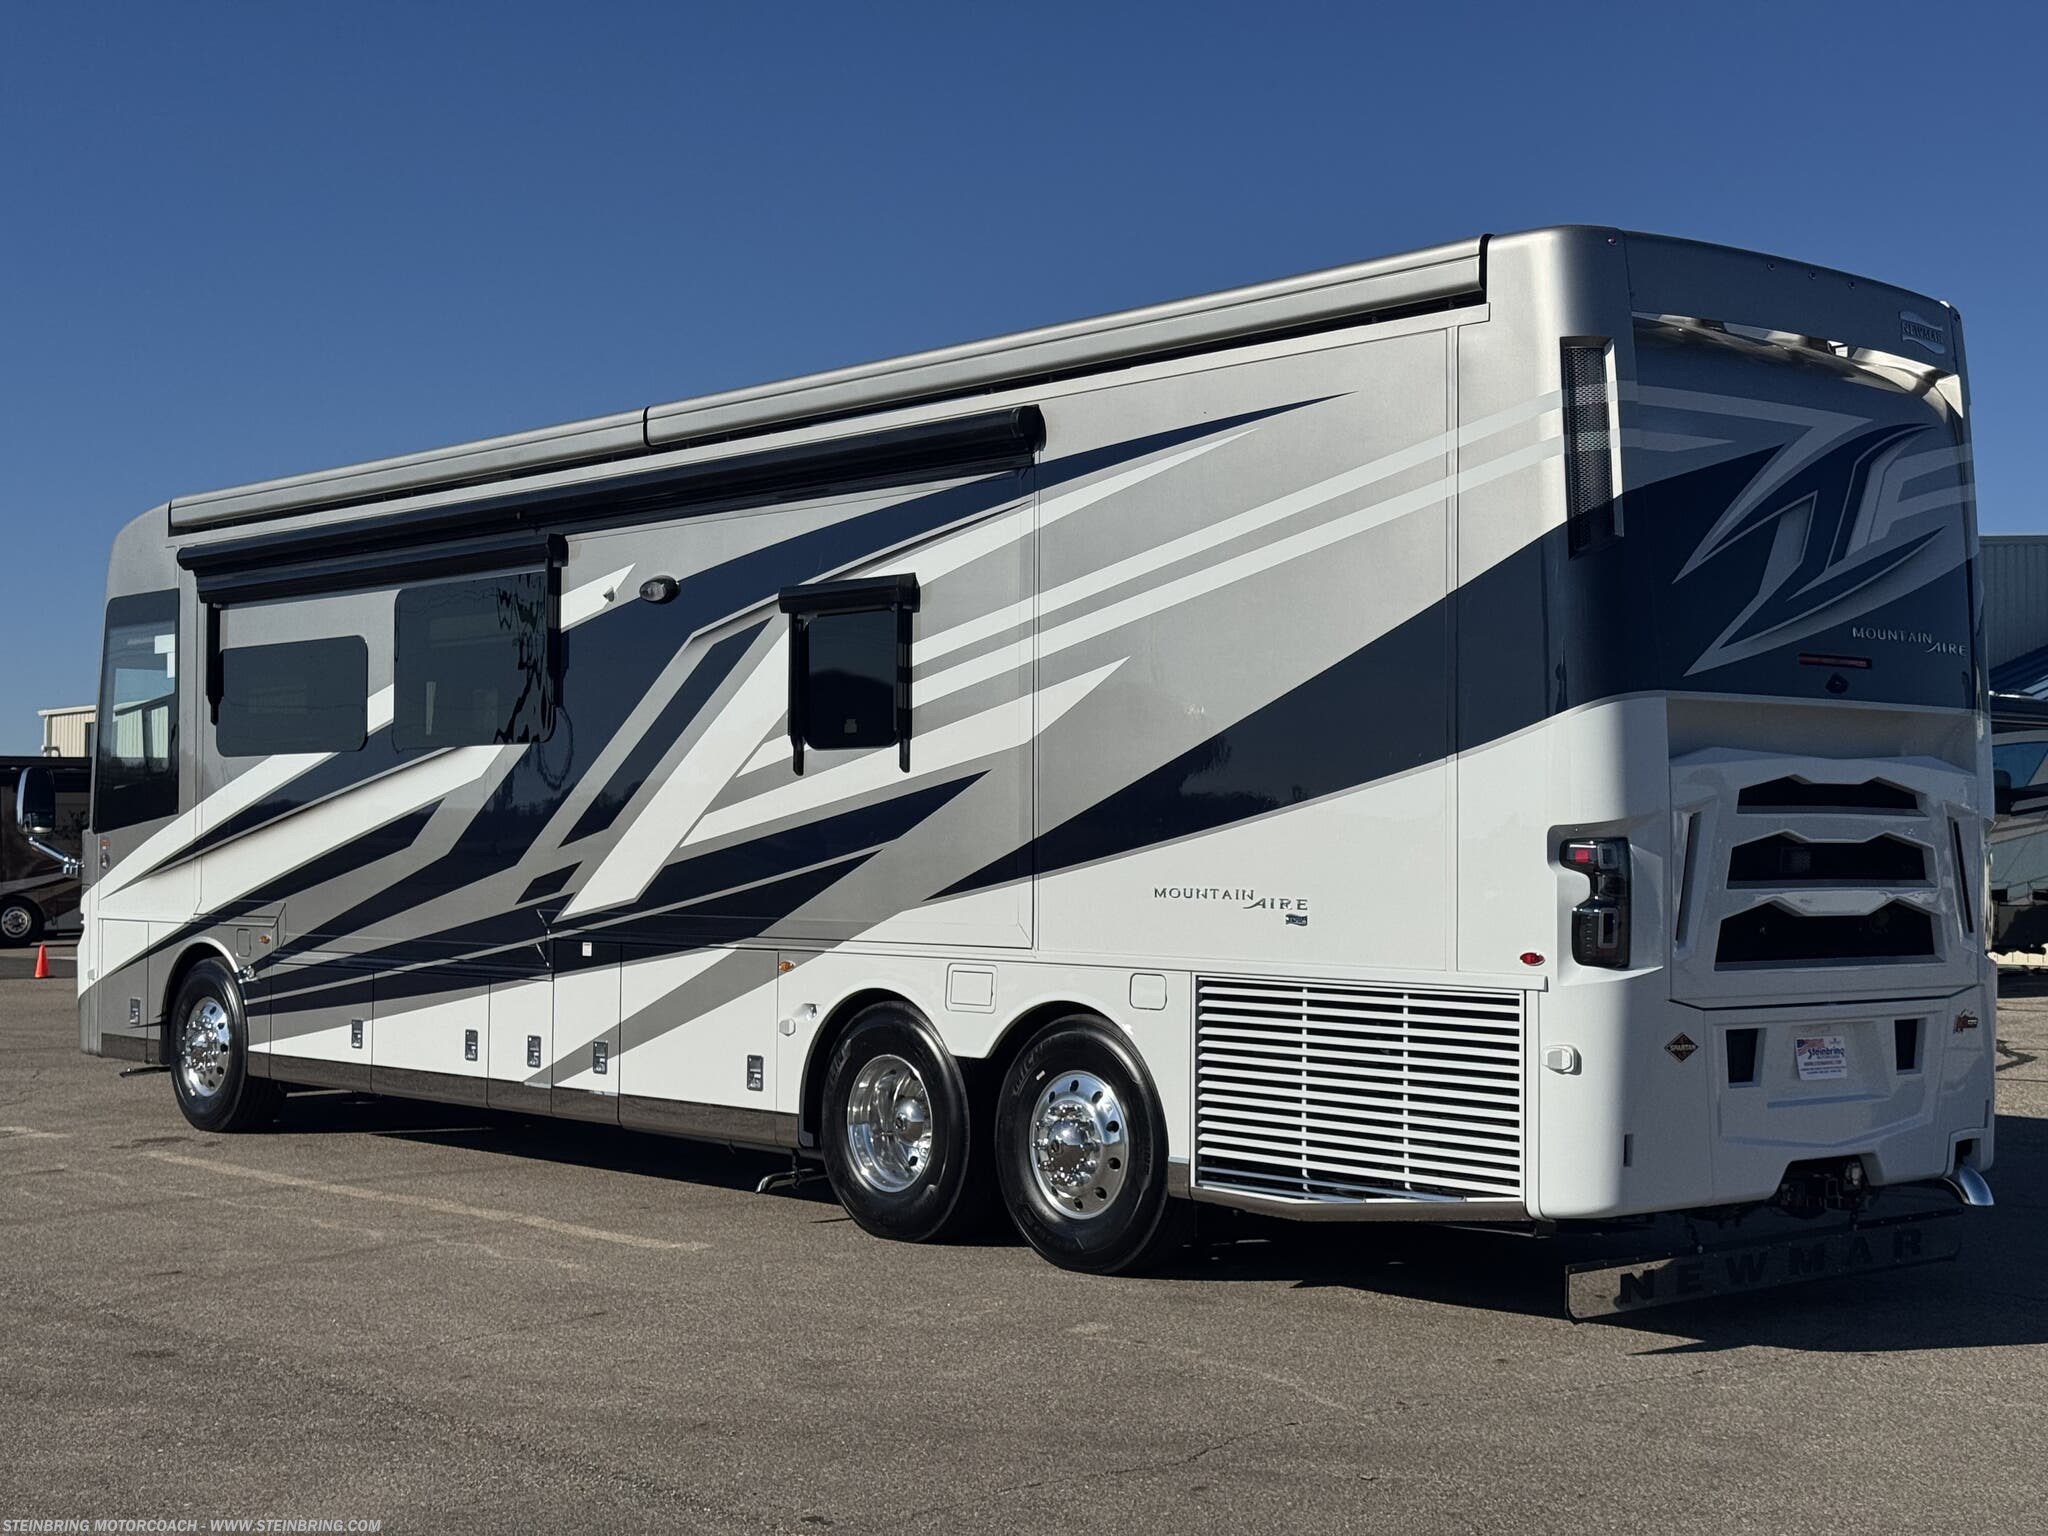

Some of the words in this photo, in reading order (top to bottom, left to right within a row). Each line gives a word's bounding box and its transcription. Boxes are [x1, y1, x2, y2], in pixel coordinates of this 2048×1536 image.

[1852, 626, 1932, 644] MOUNTAIN
[1926, 642, 1967, 656] AIRE
[1153, 887, 1255, 901] MOUNTAIN
[1243, 898, 1308, 911] AIRE
[1619, 1228, 1923, 1304] NEWMAR
